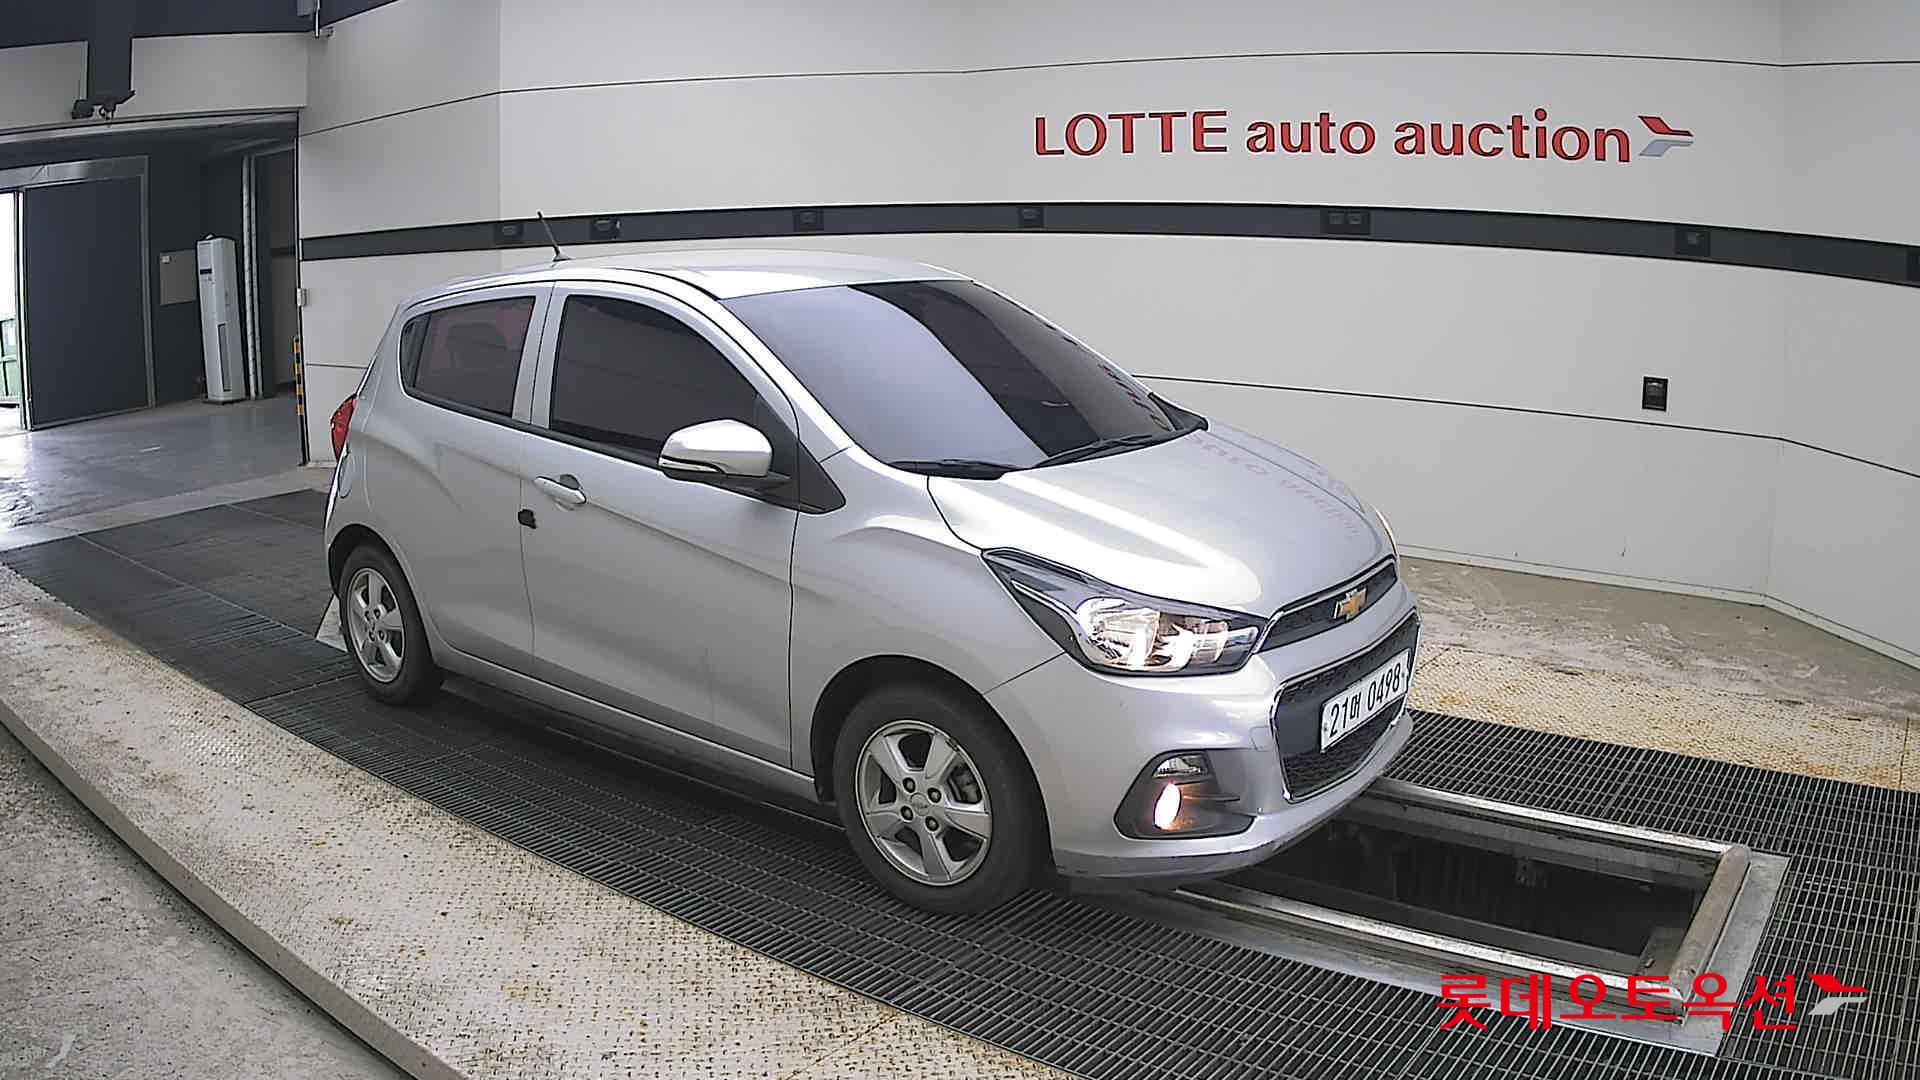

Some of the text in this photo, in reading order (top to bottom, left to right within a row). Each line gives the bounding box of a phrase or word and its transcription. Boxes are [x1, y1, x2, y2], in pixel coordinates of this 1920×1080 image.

[1035, 109, 1631, 162] LOTTE auto auction
[1329, 662, 1401, 738] 21머 0498
